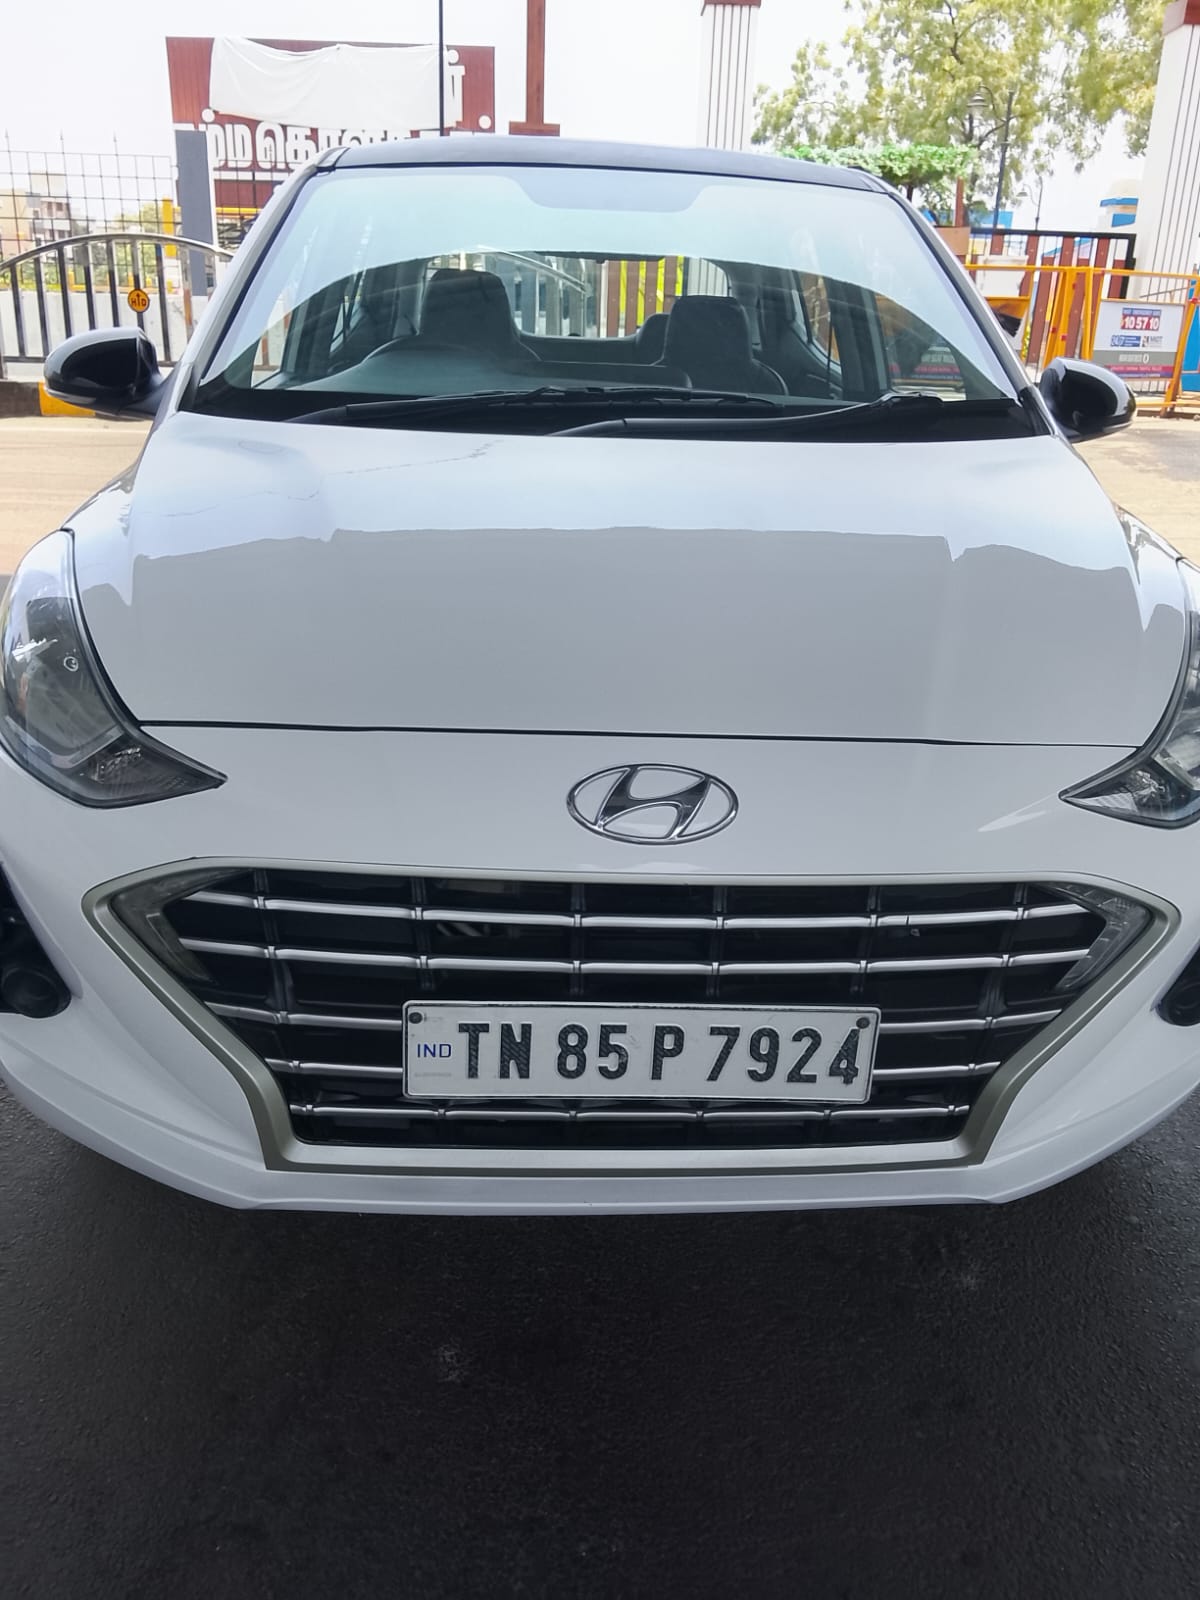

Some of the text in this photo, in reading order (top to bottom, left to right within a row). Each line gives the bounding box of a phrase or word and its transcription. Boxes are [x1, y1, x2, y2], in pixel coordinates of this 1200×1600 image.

[417, 1043, 452, 1058] IND
[458, 1023, 859, 1085] TN 85 P 7924
